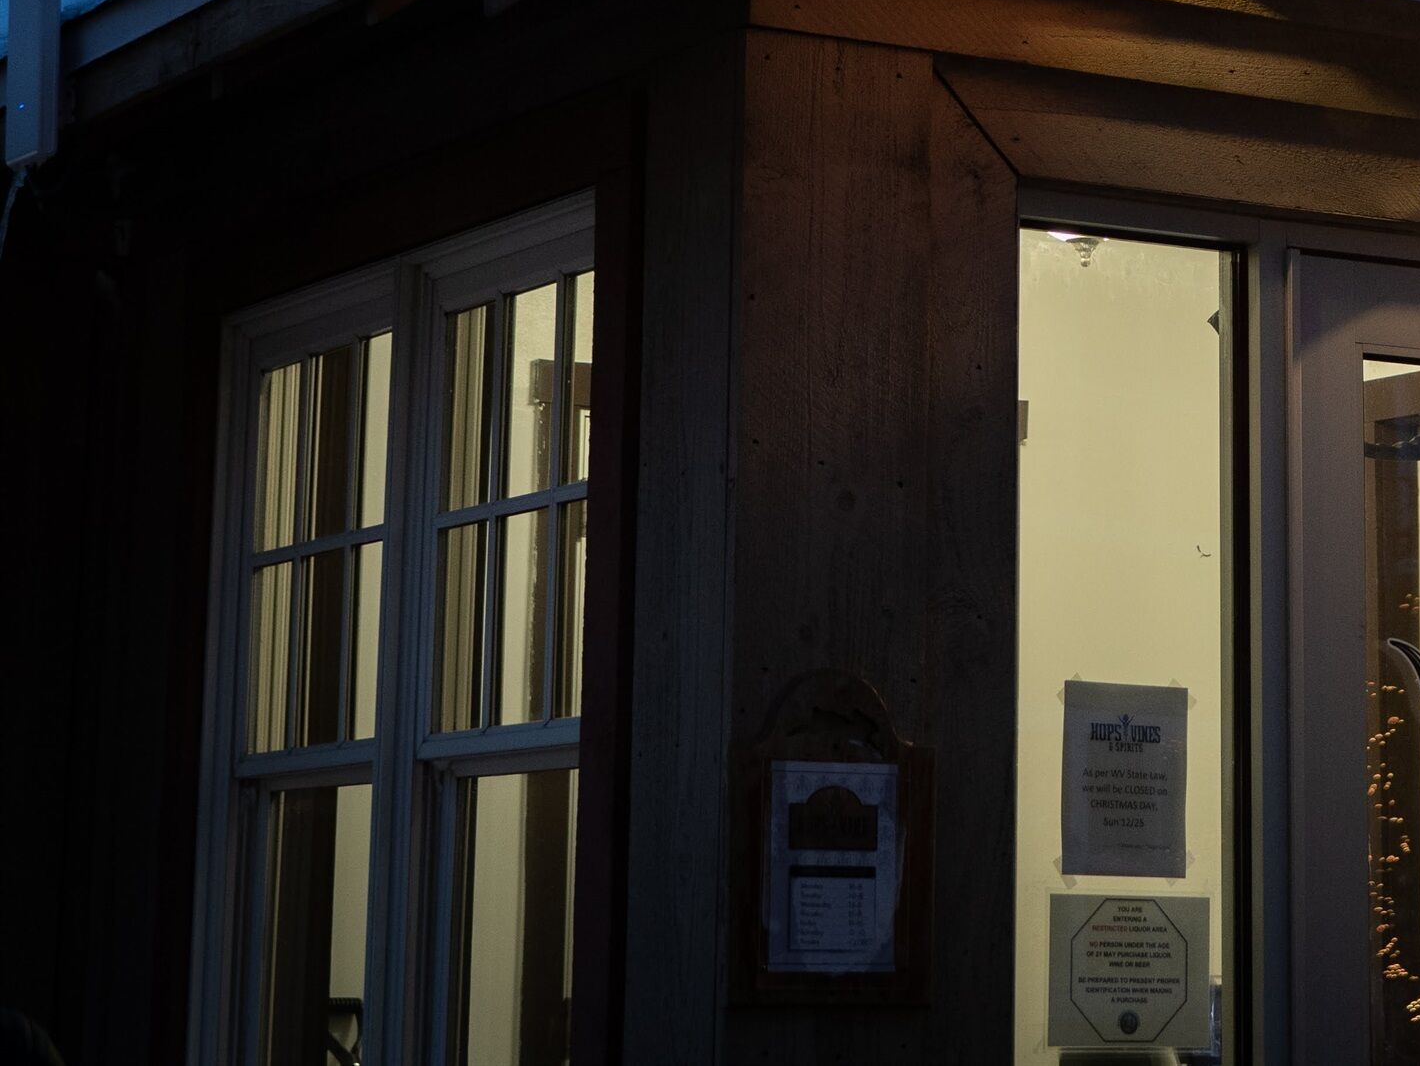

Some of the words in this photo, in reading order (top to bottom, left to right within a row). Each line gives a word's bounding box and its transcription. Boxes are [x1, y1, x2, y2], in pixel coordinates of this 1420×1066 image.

[1090, 723, 1121, 741] HOPS
[1125, 786, 1155, 795] CLOSED
[1090, 799, 1137, 810] CHRISTMAS
